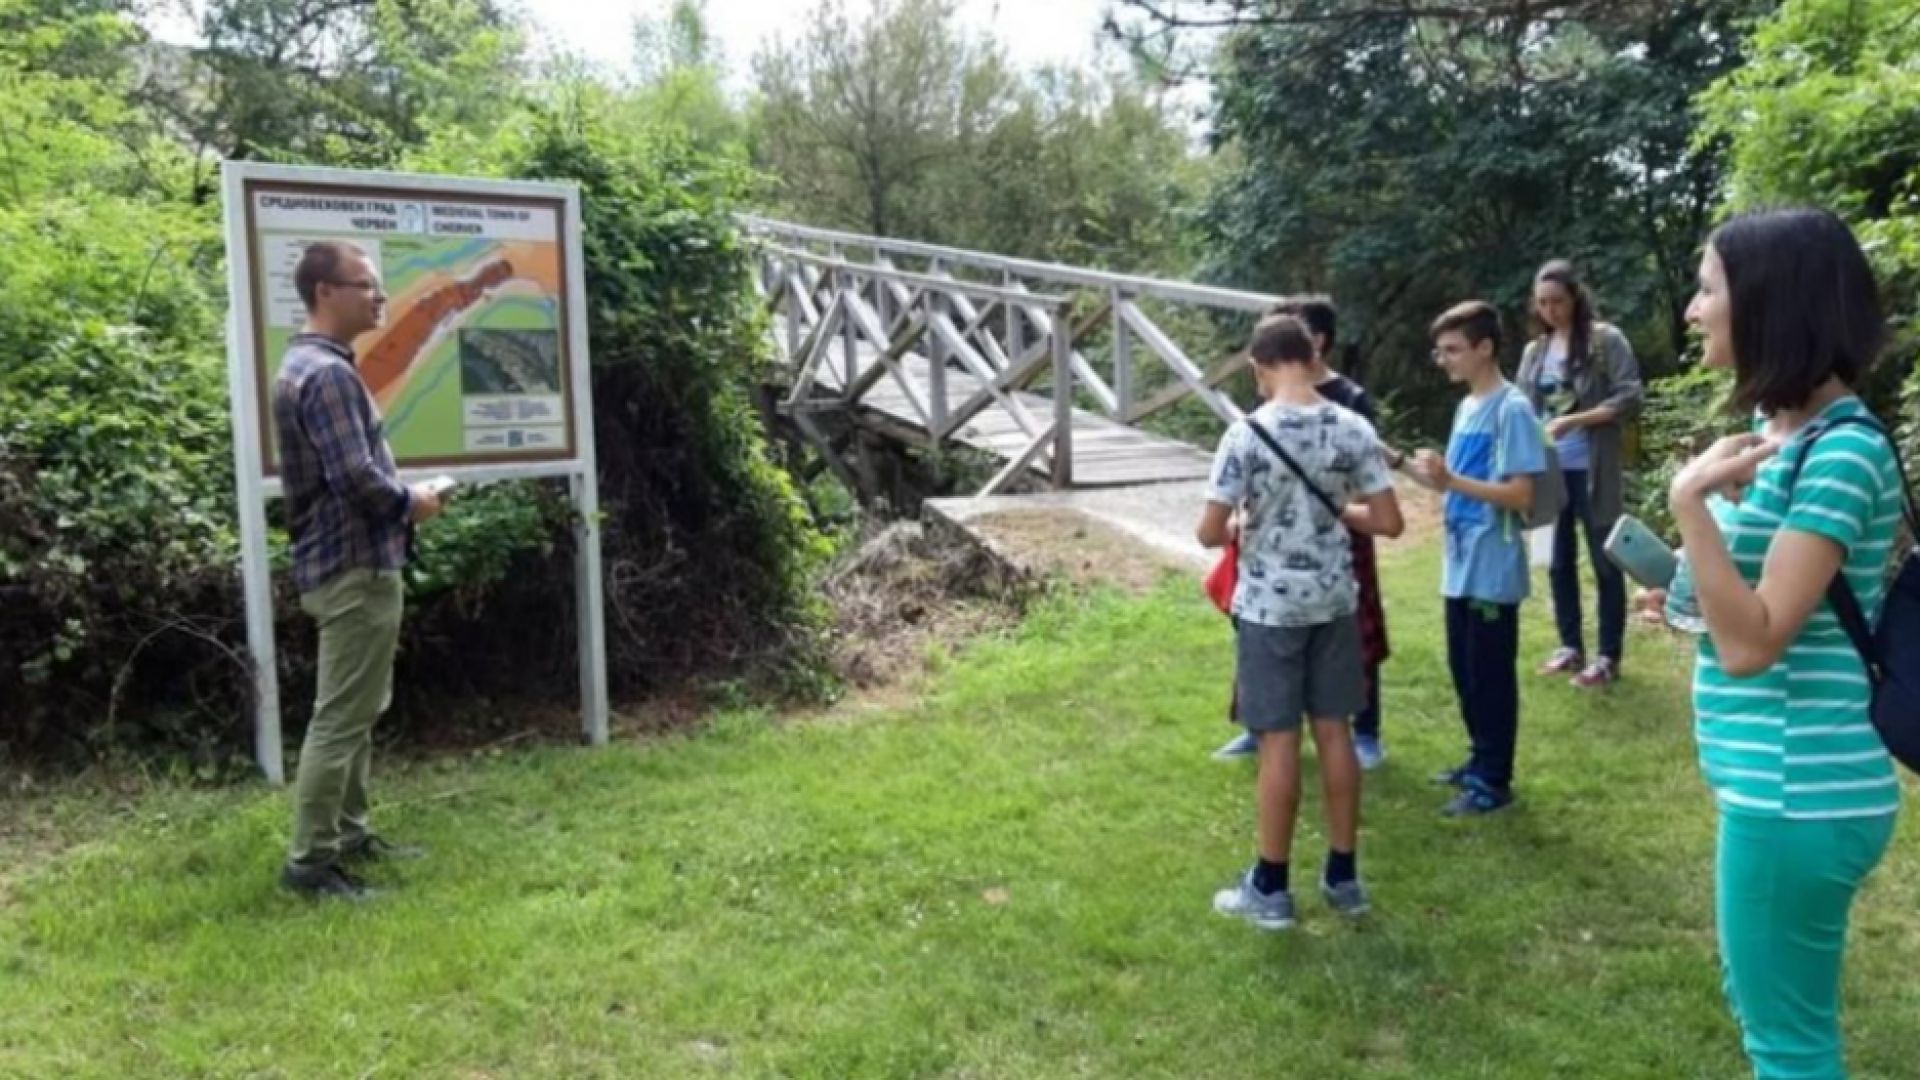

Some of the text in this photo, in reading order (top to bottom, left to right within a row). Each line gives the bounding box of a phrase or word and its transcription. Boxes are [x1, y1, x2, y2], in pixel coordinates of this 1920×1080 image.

[260, 195, 397, 215] СРЕДНОВЕКОВЕН ГРАД
[432, 206, 530, 221] MEDIEVAL TOWN OF
[351, 217, 398, 230] ЧЕРВЕН
[433, 221, 484, 234] CHERVEN
